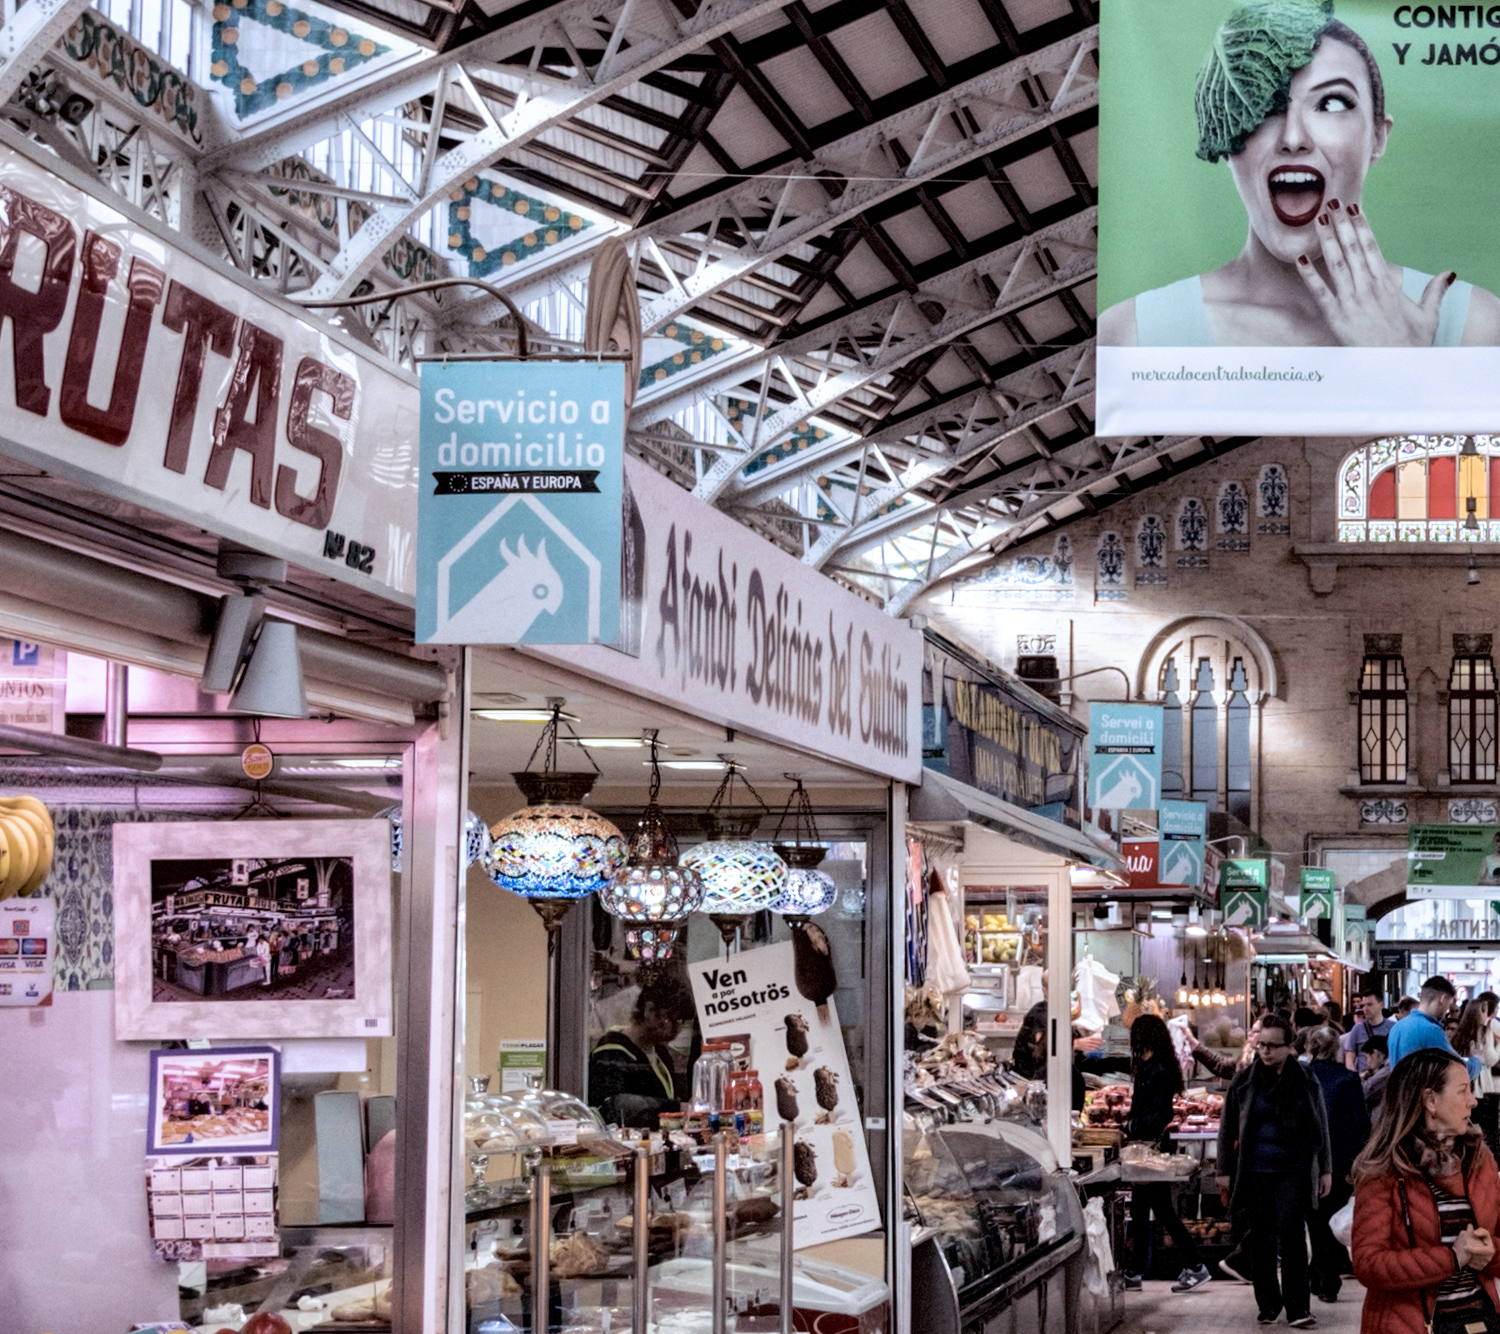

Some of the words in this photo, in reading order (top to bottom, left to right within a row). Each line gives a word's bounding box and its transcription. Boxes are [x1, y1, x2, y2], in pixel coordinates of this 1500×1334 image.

[1392, 43, 1409, 66] Y
[1131, 364, 1325, 384] mercadocentralvalencia.es
[434, 388, 579, 424] Servicio
[590, 400, 610, 425] a
[437, 432, 606, 468] domicilio
[471, 473, 521, 490] ESPAÑA
[522, 475, 530, 489] Y
[532, 474, 582, 489] EUROPA
[346, 537, 376, 574] 82
[745, 567, 823, 727] Delicias
[827, 609, 853, 740] del
[1101, 714, 1142, 730] Servei
[1146, 720, 1154, 730] a
[1100, 731, 1155, 745] domicili
[204, 892, 250, 908] FRUTAS
[25, 960, 45, 969] VISA
[702, 968, 748, 991] Ven
[704, 982, 791, 1017] nosotrös
[720, 988, 736, 999] por
